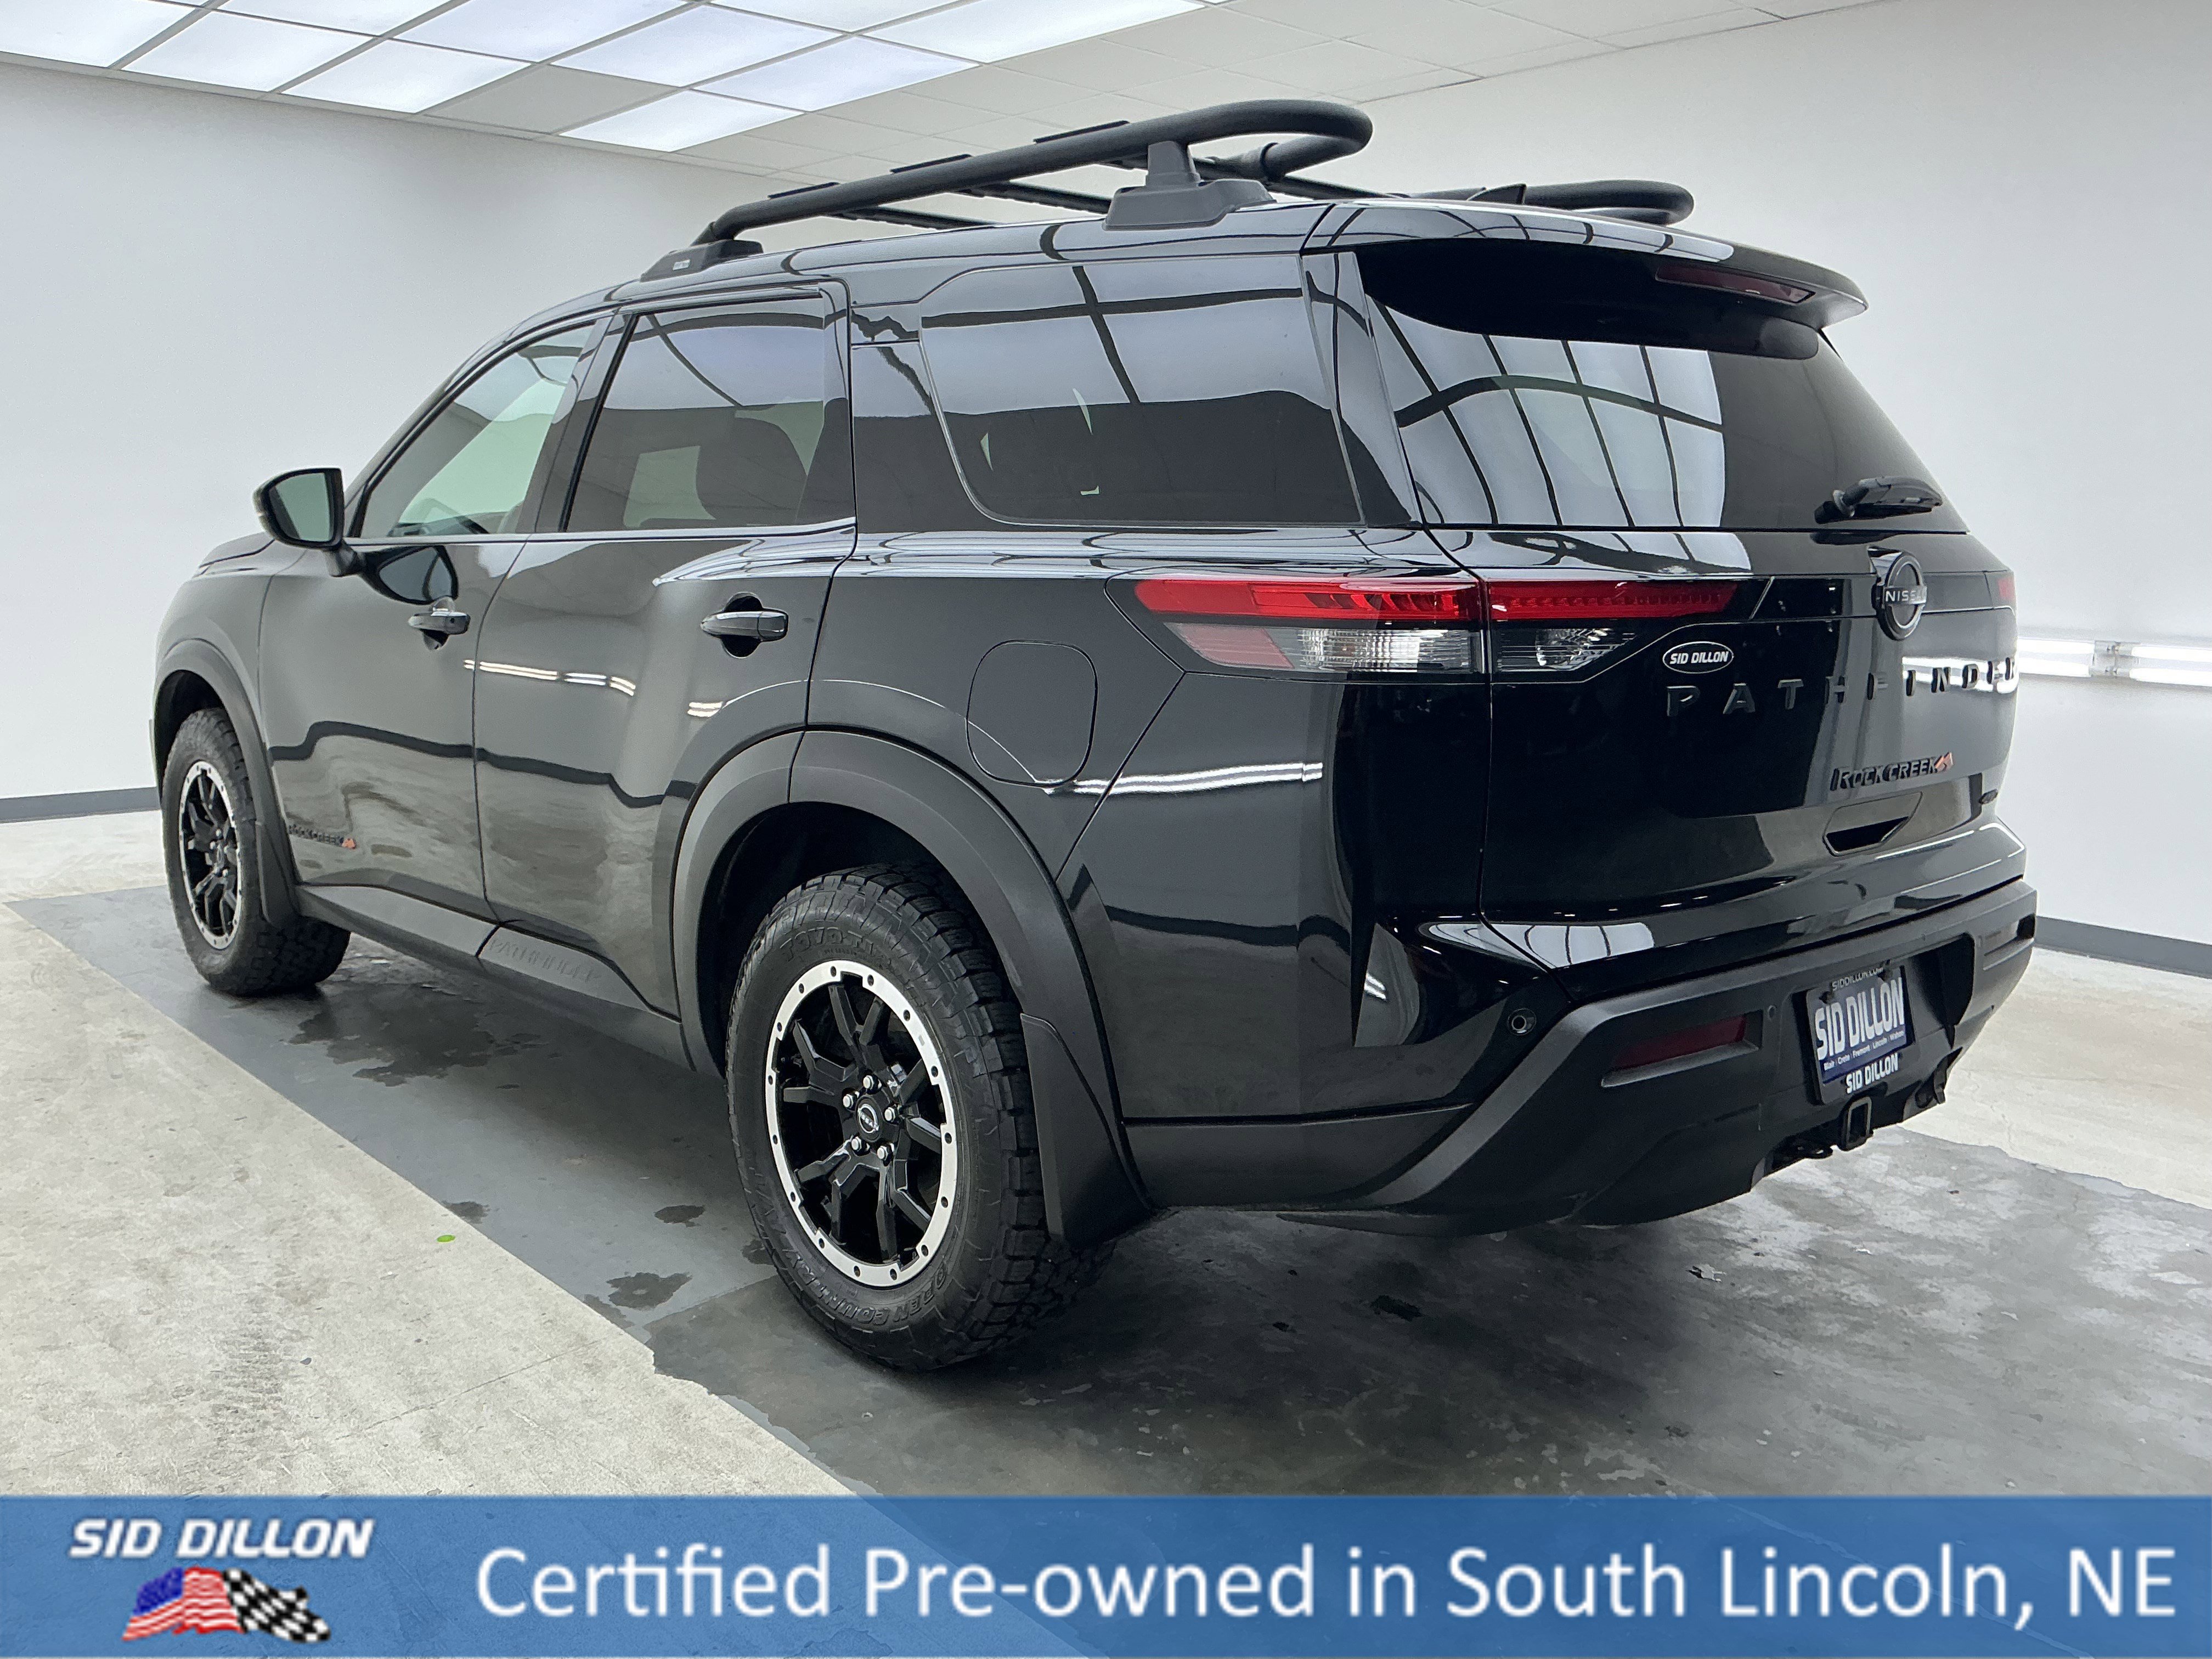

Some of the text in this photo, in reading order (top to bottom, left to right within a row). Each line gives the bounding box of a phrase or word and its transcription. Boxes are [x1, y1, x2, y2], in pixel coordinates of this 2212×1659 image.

[1886, 589, 1926, 602] NISS
[1669, 651, 1729, 664] SID DILLON
[1814, 977, 1905, 1061] SID DILLON
[1846, 1052, 1898, 1094] SID DILLON
